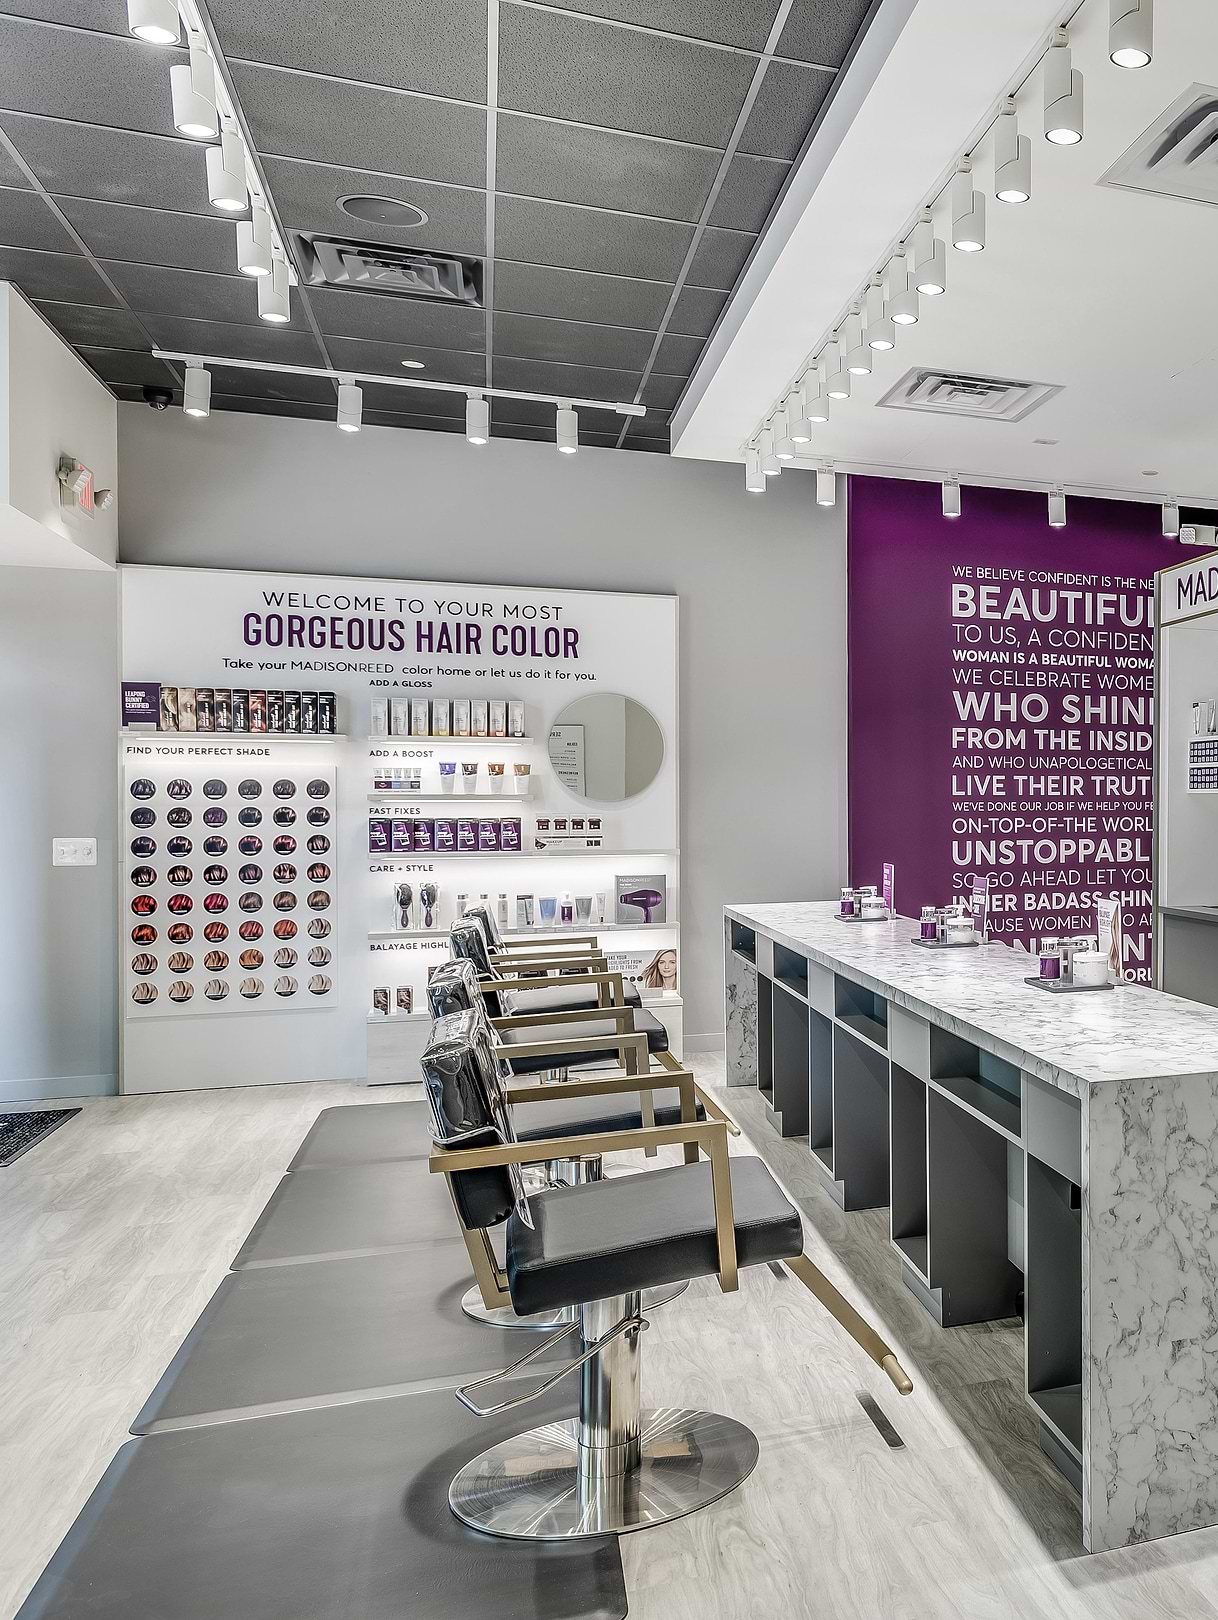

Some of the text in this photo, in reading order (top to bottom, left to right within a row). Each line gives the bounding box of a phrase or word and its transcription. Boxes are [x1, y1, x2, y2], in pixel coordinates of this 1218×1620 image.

[952, 565, 973, 578] WE
[976, 567, 1025, 582] BELIEVE
[1028, 571, 1098, 586] CONFIDENT
[1101, 575, 1111, 587] IS
[1114, 576, 1137, 589] THE
[262, 591, 563, 621] WELCOME TO YOUR MOST
[243, 612, 579, 659] GORGEOUS HAIR COLOR
[952, 623, 1154, 652] TO US, A CONFIDEN
[952, 649, 1009, 664] WOMAN
[1013, 653, 1025, 665] IS
[1028, 653, 1038, 665] A
[1041, 653, 1112, 669] BEAUTIFUL
[222, 657, 597, 682] Take your MADISONREED color home or let us do it for you.
[952, 668, 1154, 691] WE CELEBRATE WOME
[369, 679, 390, 687] ADD
[952, 690, 1049, 723] WHO
[952, 727, 1153, 752] FROM THE INSID
[126, 746, 270, 757] FIND YOUR PERFECT SHADE
[369, 750, 434, 758] ADD A BOOST
[952, 755, 1153, 770] AND WHO UNAPOLOGETICAL
[952, 775, 1153, 796] LIVE THEIR TRUT
[369, 807, 421, 815] FAST FIXES
[952, 801, 985, 812] WE'VE
[987, 801, 1017, 812] DONE
[1019, 801, 1042, 811] OUR
[1044, 801, 1064, 811] JOB
[1066, 801, 1075, 811] IF
[1077, 801, 1094, 811] WE
[1095, 801, 1120, 811] HELP
[1122, 801, 1142, 811] YOU
[952, 816, 1154, 834] ON-TOP-OF-THE WORL
[952, 838, 1153, 866] UNSTOPPABL
[369, 864, 394, 873] CARE
[405, 863, 434, 873] STYLE
[952, 872, 978, 889] SO
[985, 871, 1014, 888] GO
[1019, 870, 1081, 888] AHEAD
[1086, 868, 1116, 885] LET
[952, 893, 1018, 913] INER
[1023, 891, 1103, 912] BADASS
[1028, 914, 1092, 932] WOMEN
[370, 941, 449, 951] BALAYAGE HIGHL
[1123, 967, 1153, 982] ORL
